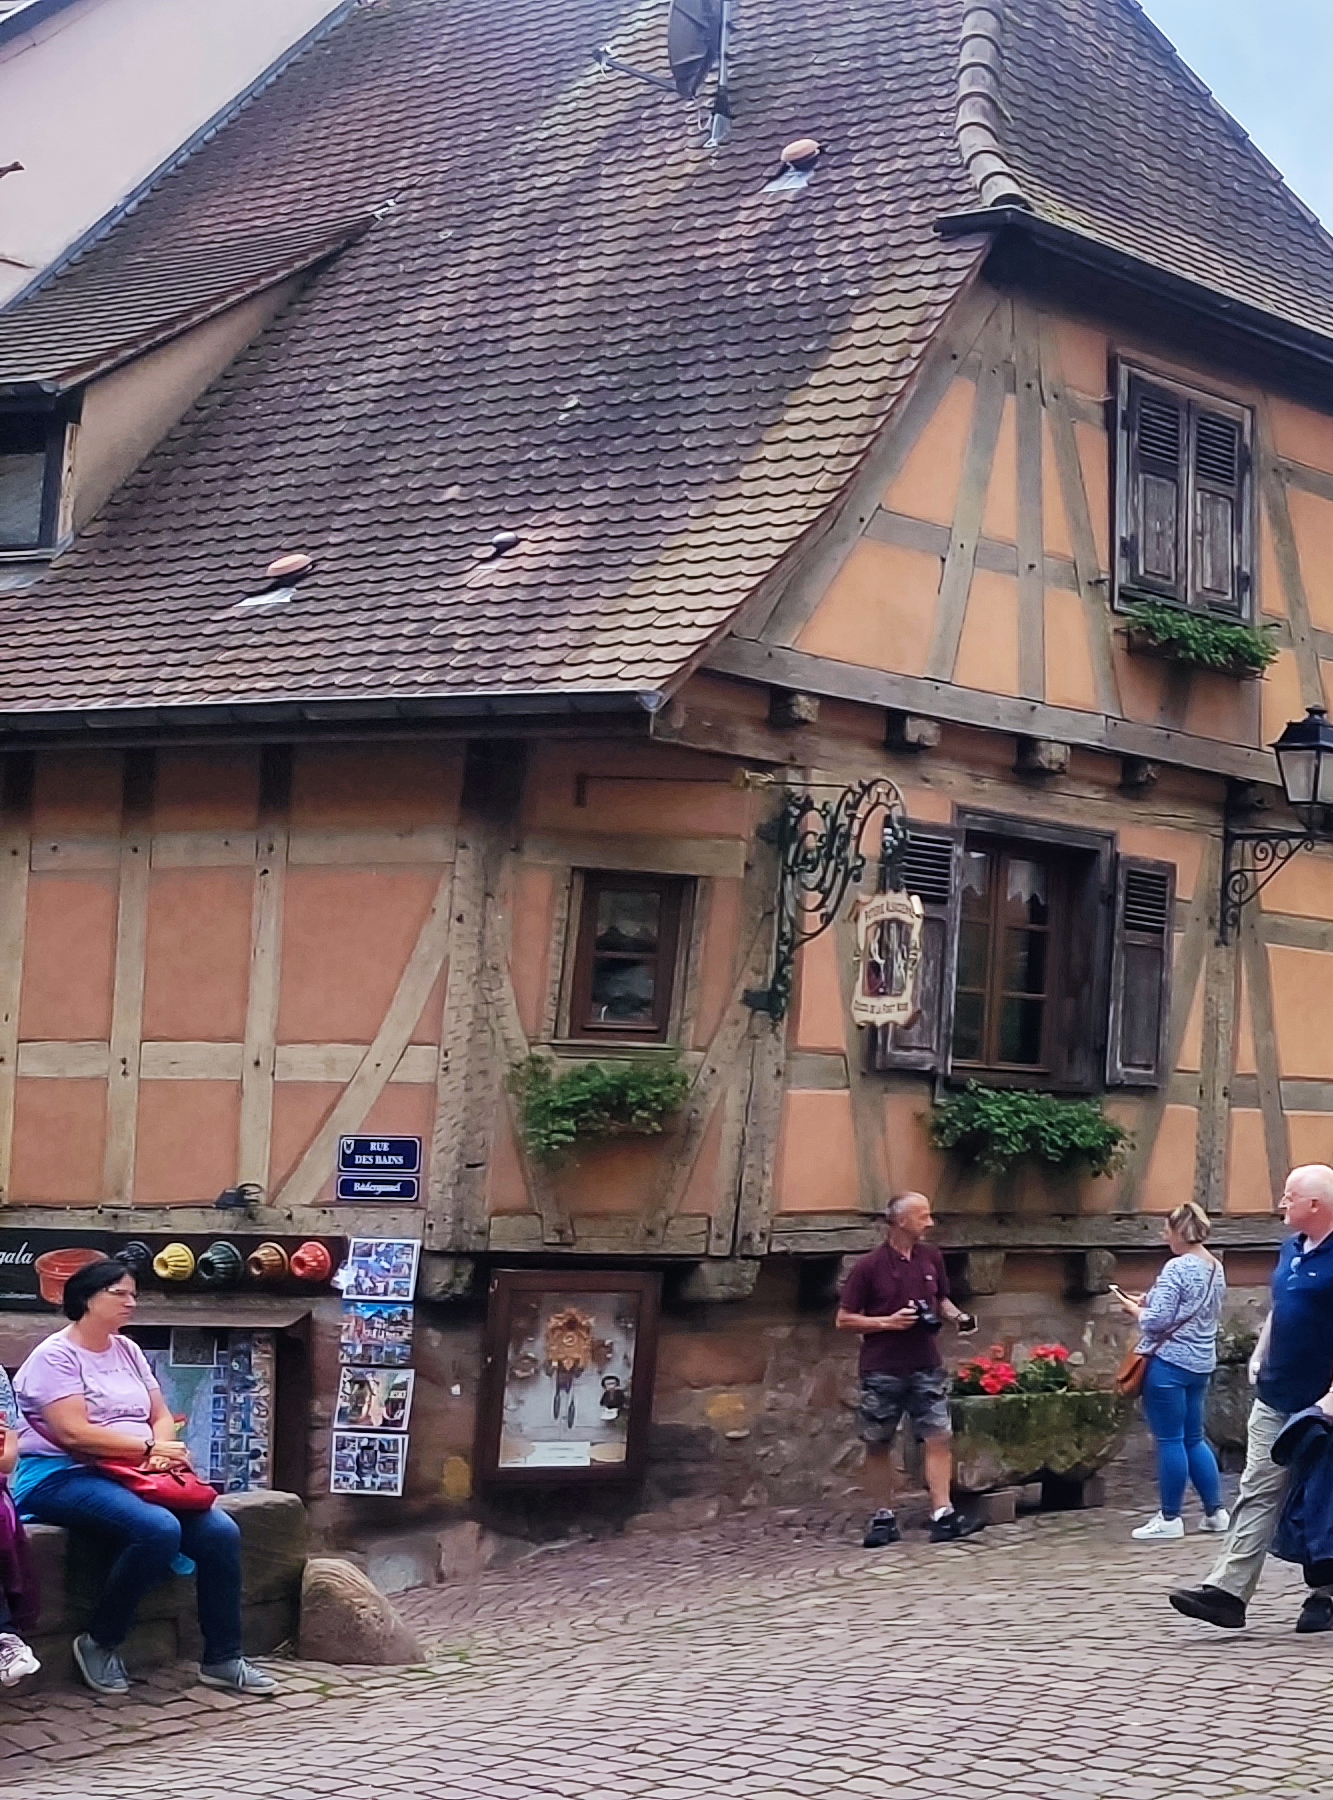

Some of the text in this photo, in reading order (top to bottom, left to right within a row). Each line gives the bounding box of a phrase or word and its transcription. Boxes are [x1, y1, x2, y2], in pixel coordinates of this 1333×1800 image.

[369, 1141, 391, 1152] RUE
[354, 1154, 404, 1165] DES BAINS
